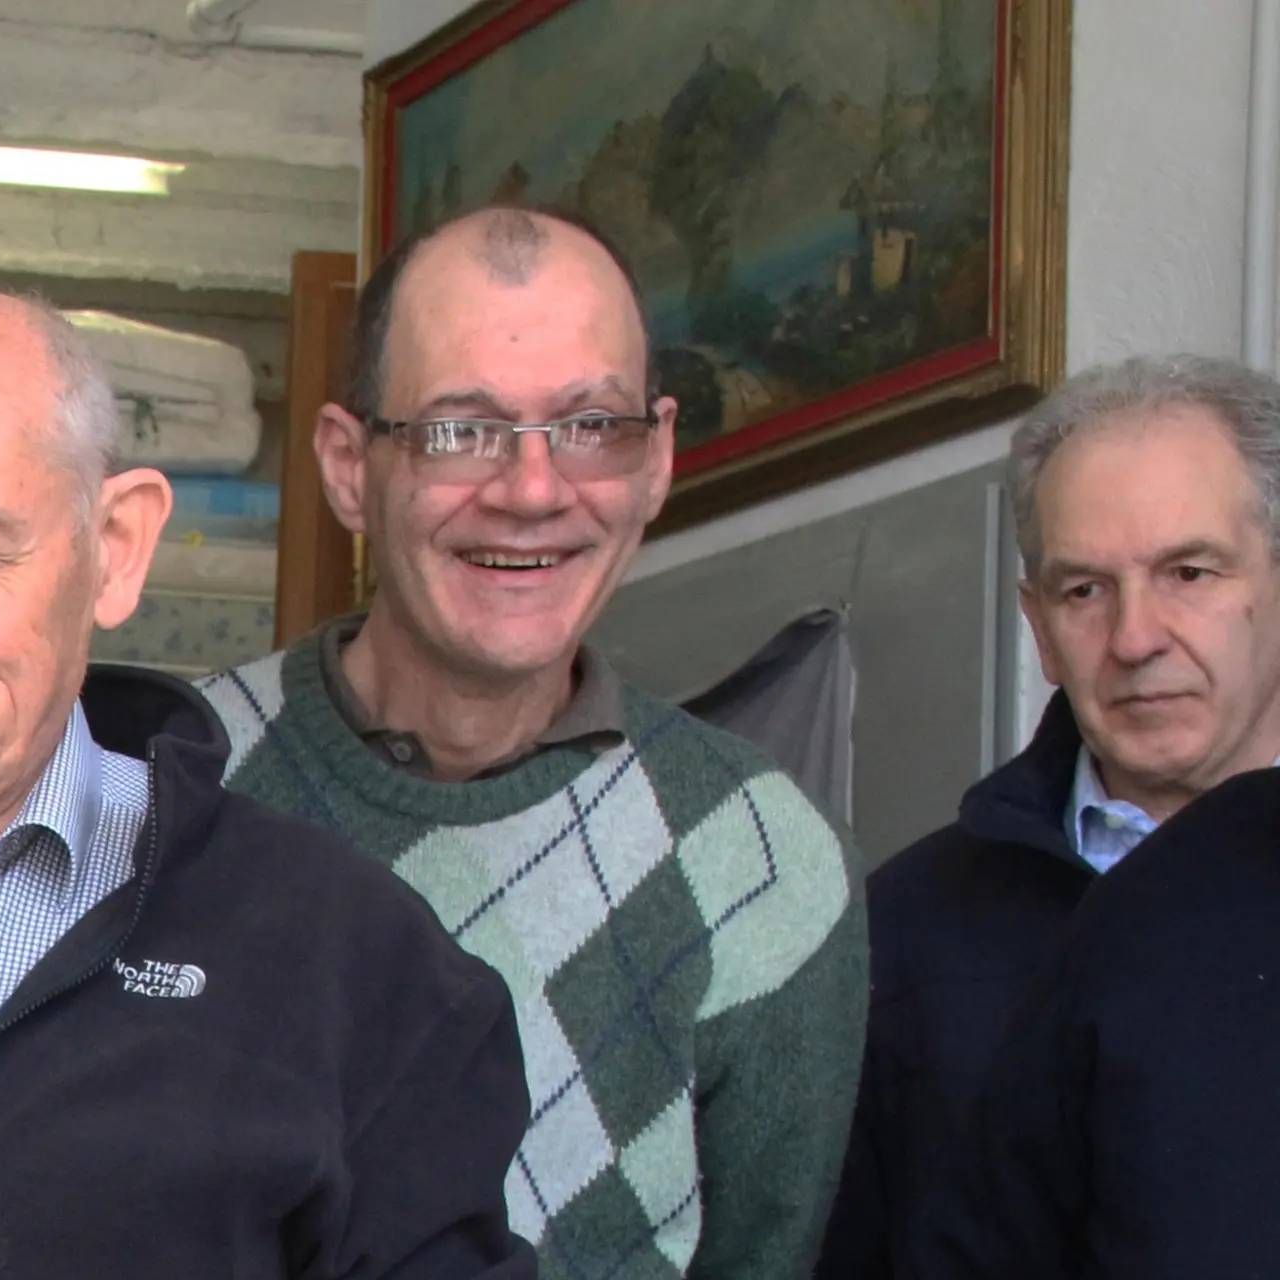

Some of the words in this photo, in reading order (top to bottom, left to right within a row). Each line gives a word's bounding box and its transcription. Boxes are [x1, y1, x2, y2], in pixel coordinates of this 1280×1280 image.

[113, 957, 177, 986] NORTH
[143, 958, 180, 976] THE
[123, 980, 171, 998] FACE
